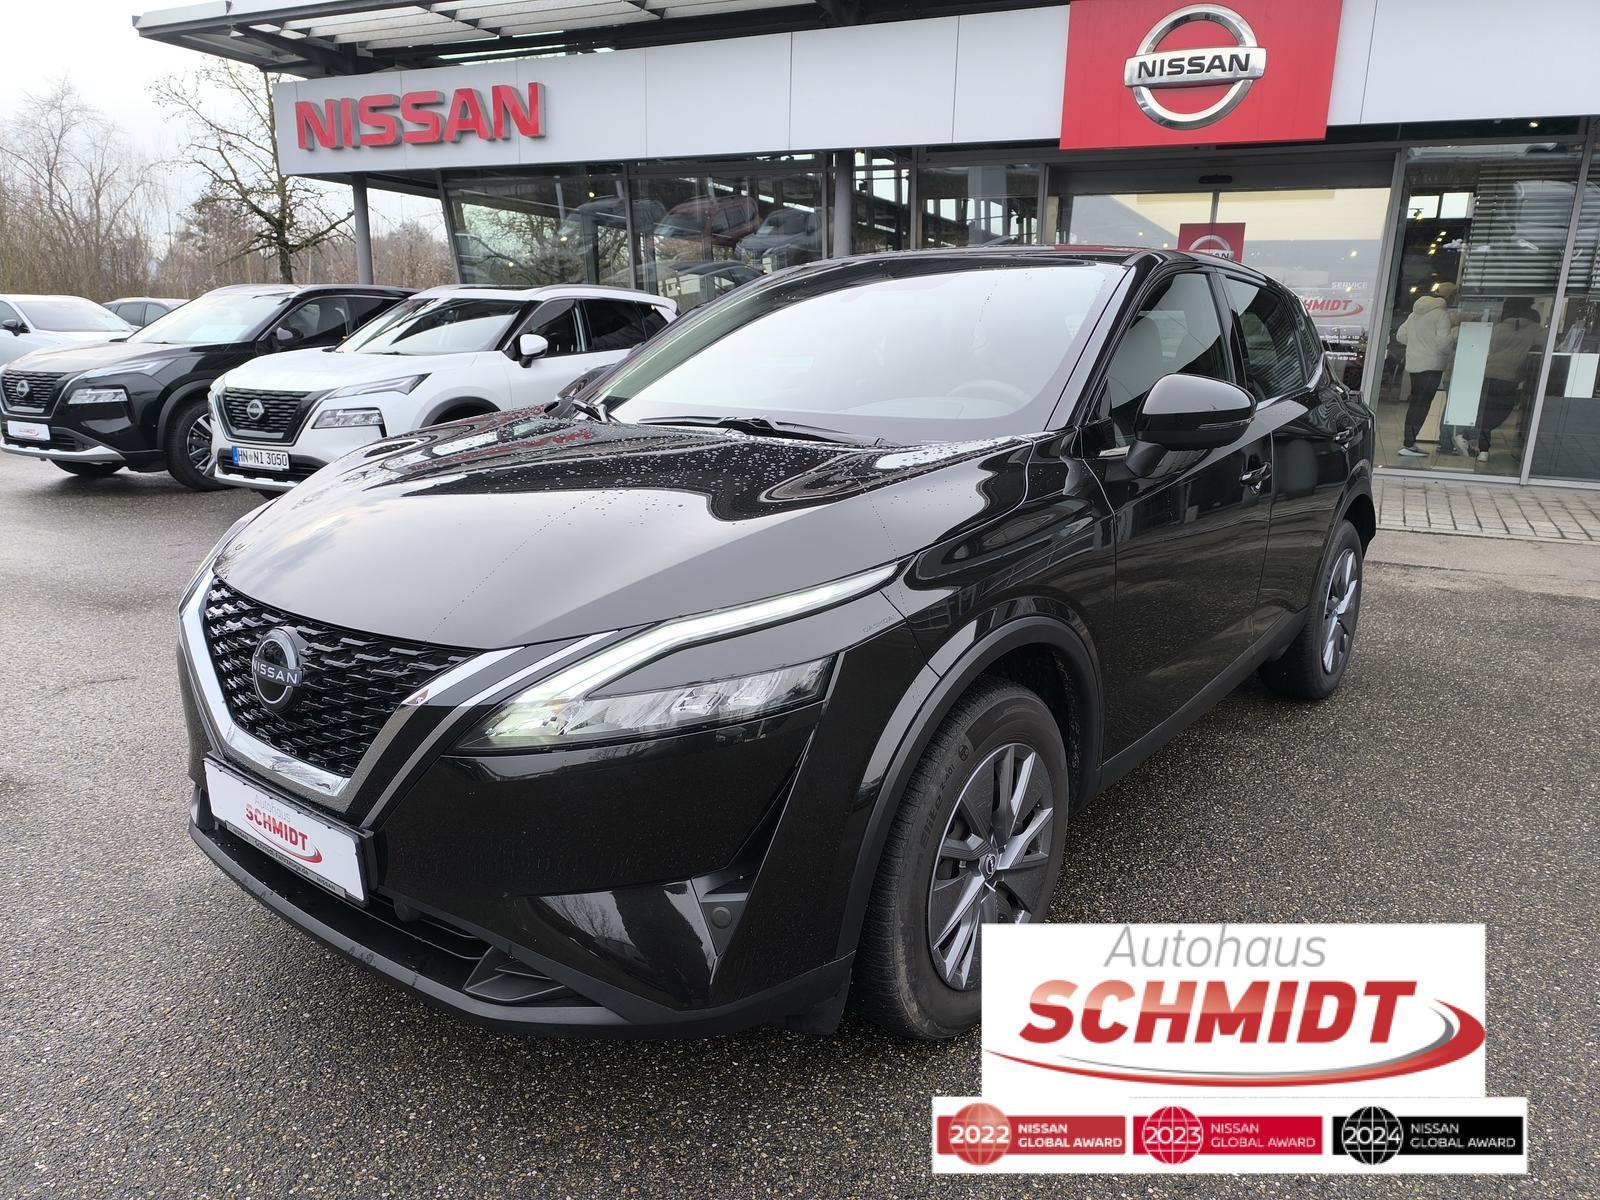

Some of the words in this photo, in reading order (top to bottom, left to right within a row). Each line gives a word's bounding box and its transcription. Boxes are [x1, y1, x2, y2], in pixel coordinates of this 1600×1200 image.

[1138, 53, 1250, 79] NISSAN
[295, 82, 546, 150] NISSAN
[1331, 281, 1368, 289] SERVICE
[1303, 299, 1352, 310] HMIDT
[238, 450, 249, 463] HN
[253, 451, 264, 464] NI
[266, 452, 288, 467] 3050
[254, 660, 298, 684] NISSAN
[246, 803, 308, 851] SCHMIDT
